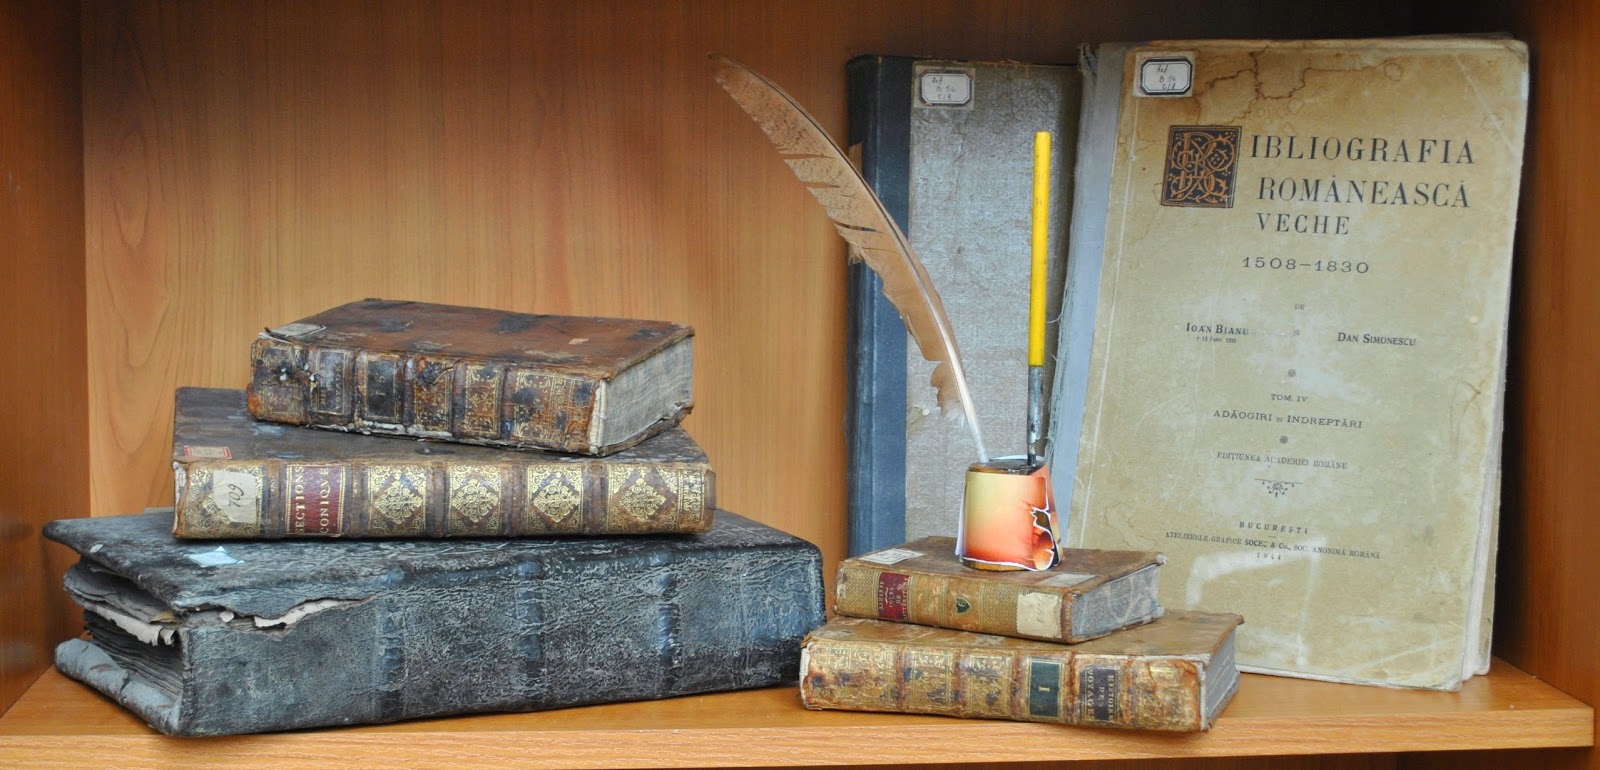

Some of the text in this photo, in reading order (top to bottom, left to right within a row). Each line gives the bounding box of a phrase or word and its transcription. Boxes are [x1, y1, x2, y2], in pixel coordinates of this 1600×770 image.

[1256, 212, 1351, 236] VECHE
[1215, 324, 1250, 336] BIANU
[1337, 332, 1417, 347] DAN SIMONESCU
[1296, 395, 1308, 403] IV
[1264, 456, 1310, 467] ACADEMIEI
[294, 465, 306, 534] SECTIONS
[319, 467, 331, 535] CONIQVE
[1165, 531, 1209, 542] ATELIERELE
[1211, 535, 1242, 545] GRAFICE
[1294, 544, 1309, 552] SOC.
